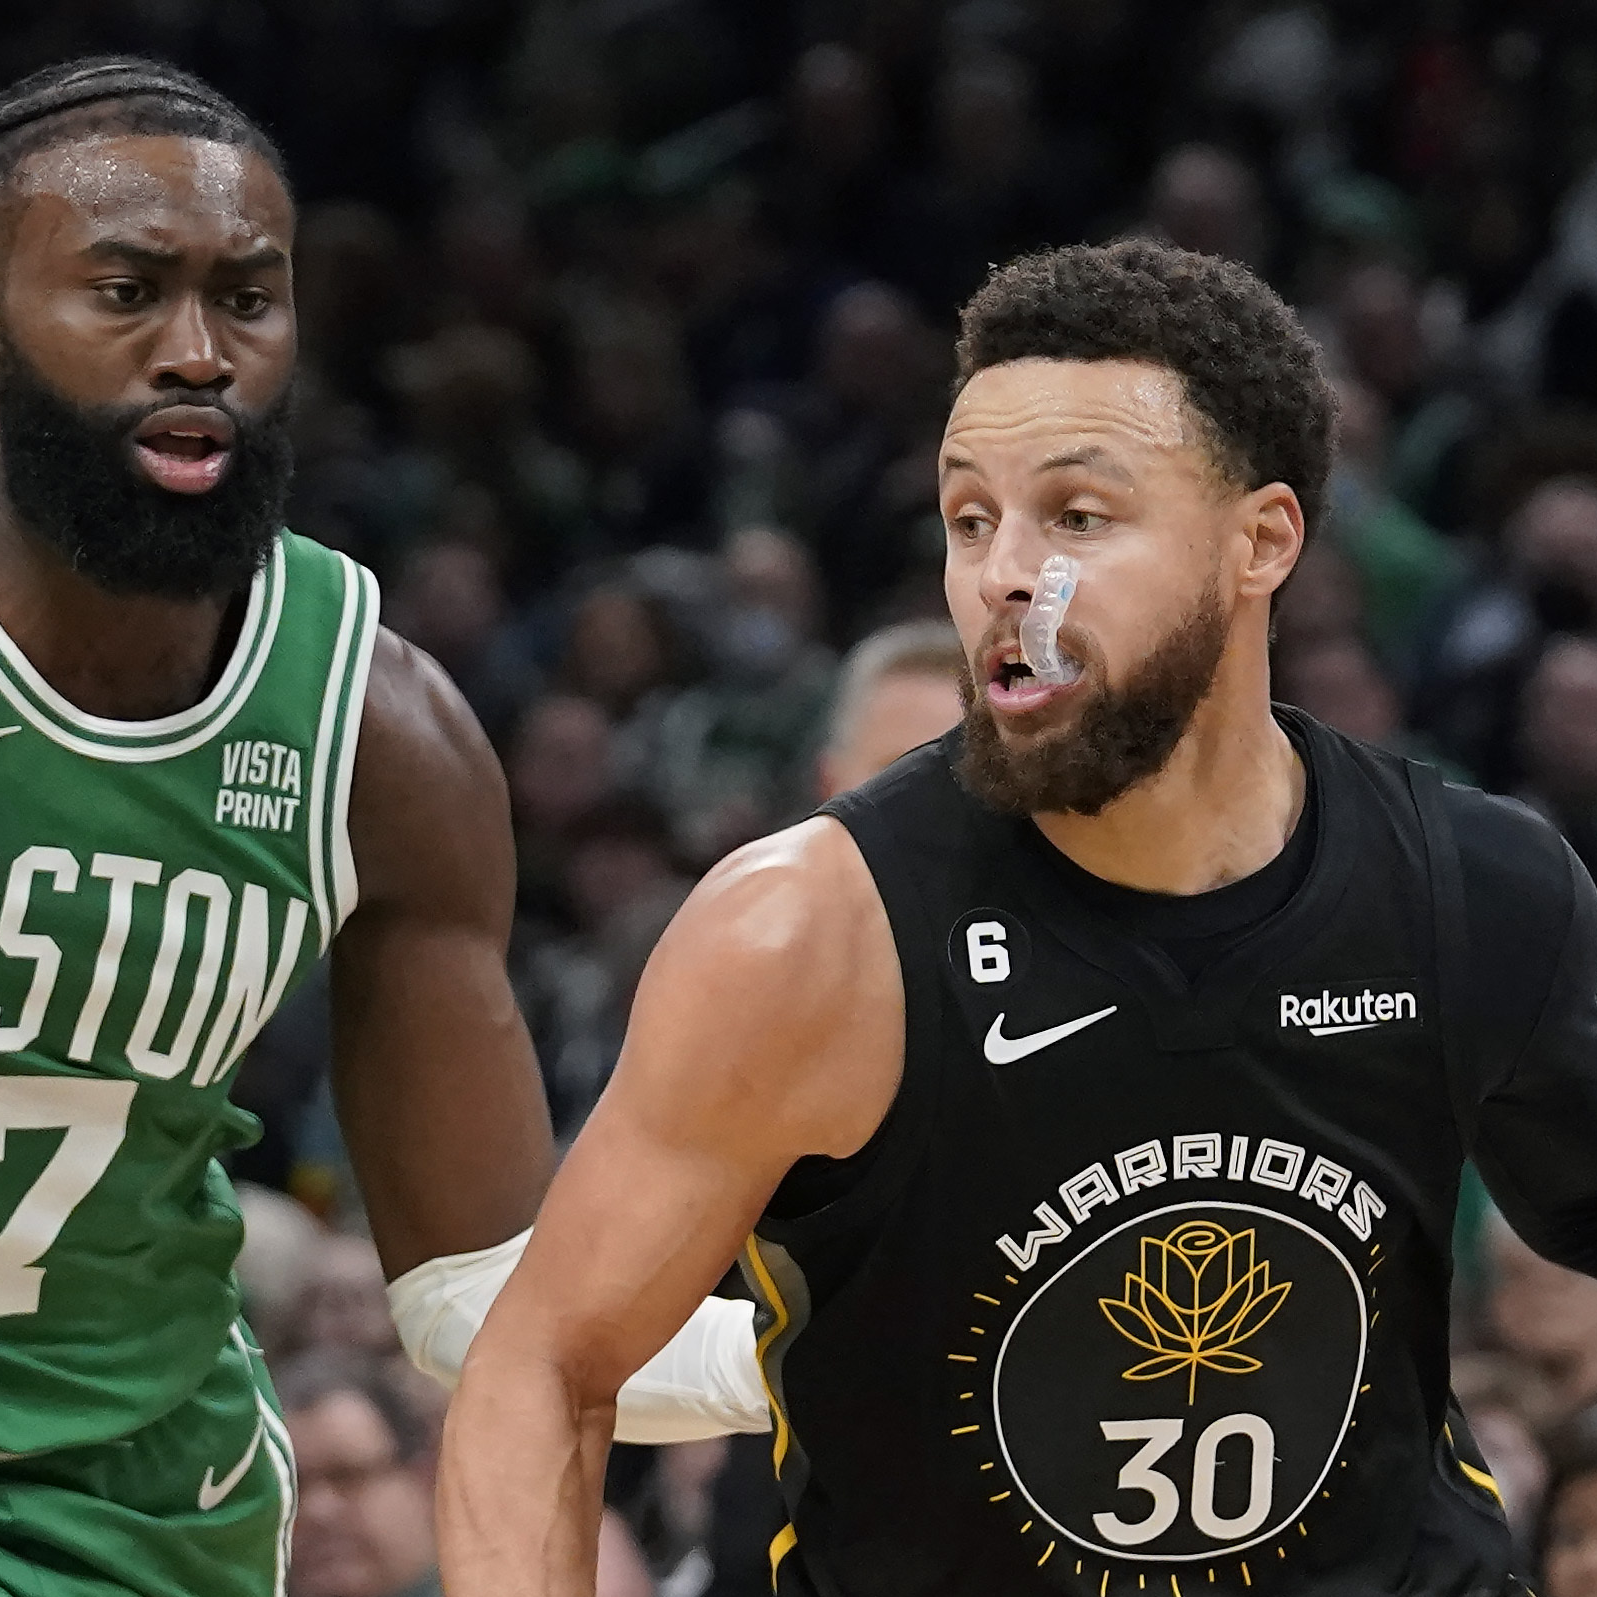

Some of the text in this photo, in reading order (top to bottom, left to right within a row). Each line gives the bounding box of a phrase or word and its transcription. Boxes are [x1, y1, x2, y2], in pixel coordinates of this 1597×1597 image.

[222, 740, 302, 797] VISTA
[215, 788, 301, 832] PRINT
[966, 920, 1011, 983] 6
[1280, 988, 1417, 1028] Rakuten
[995, 1132, 1388, 1272] WARRIORS
[1092, 1412, 1276, 1546] 30
